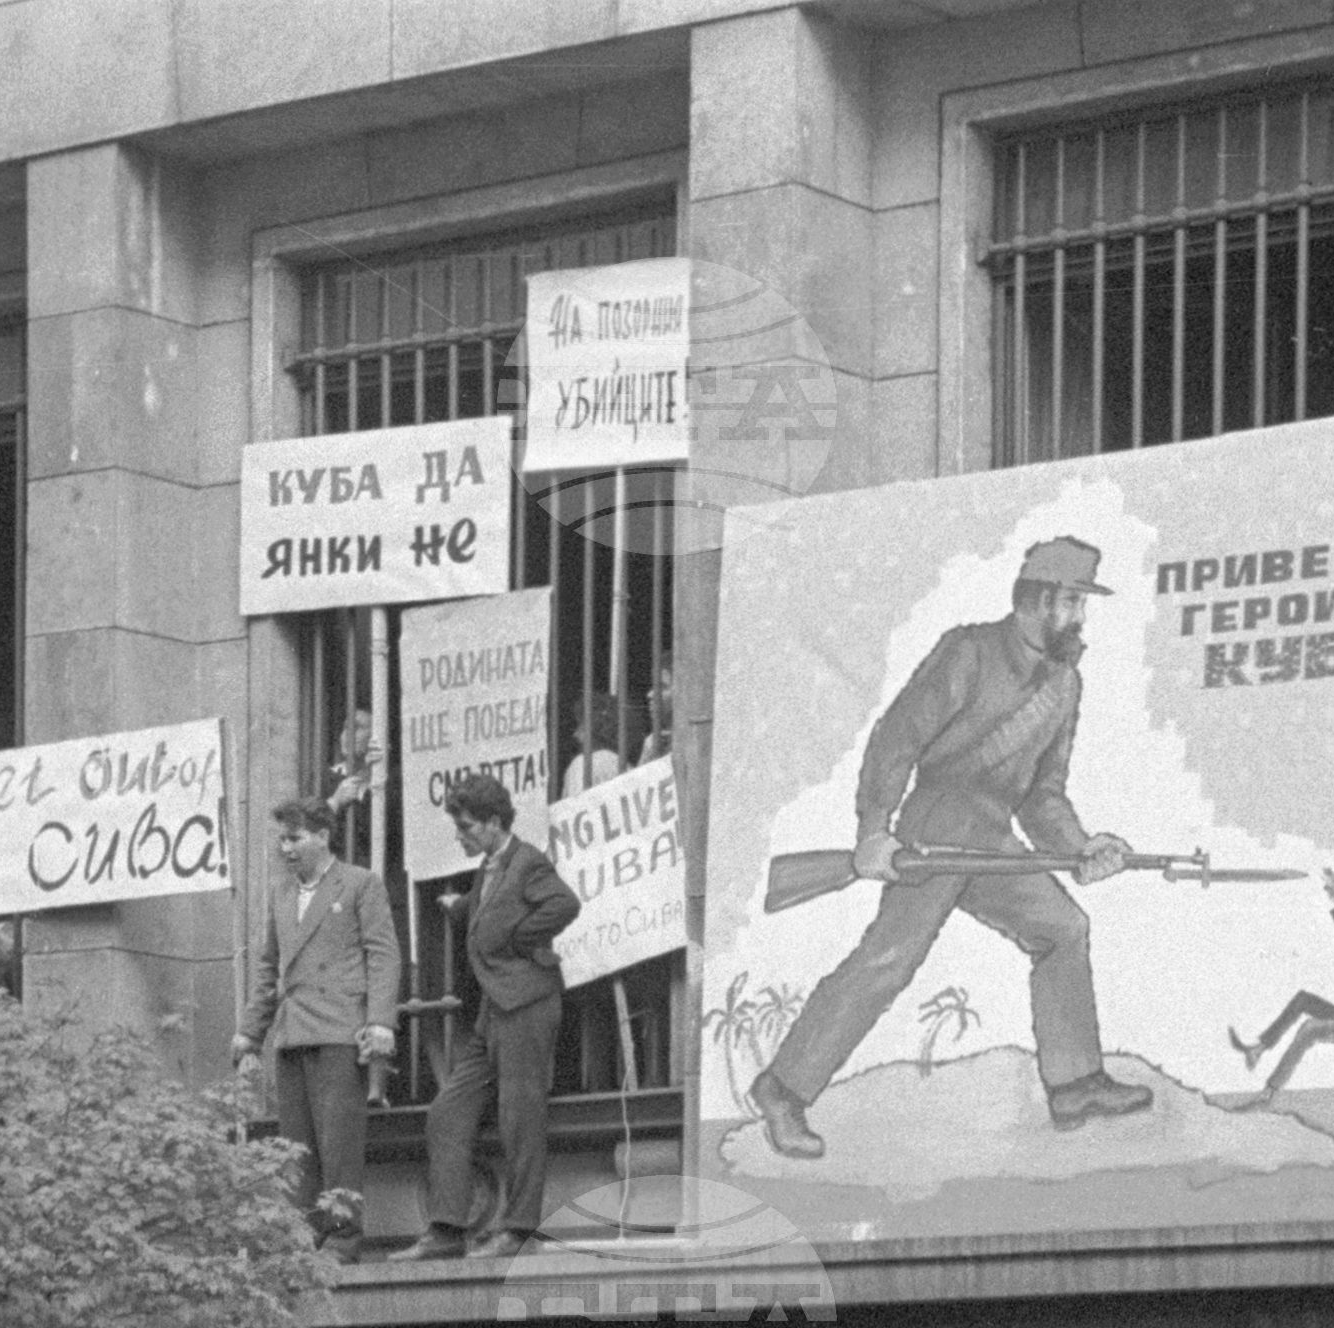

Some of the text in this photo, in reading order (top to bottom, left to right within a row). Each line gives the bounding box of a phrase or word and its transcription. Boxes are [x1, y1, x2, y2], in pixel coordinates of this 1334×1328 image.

[548, 293, 583, 350] НА
[268, 445, 485, 507] КУБА ДА
[261, 534, 383, 580] ЯНКИ
[418, 638, 545, 693] РОДИНАТА
[409, 709, 452, 754] ЩЕ
[548, 774, 676, 866] NG LIVE
[578, 830, 678, 902] UBA
